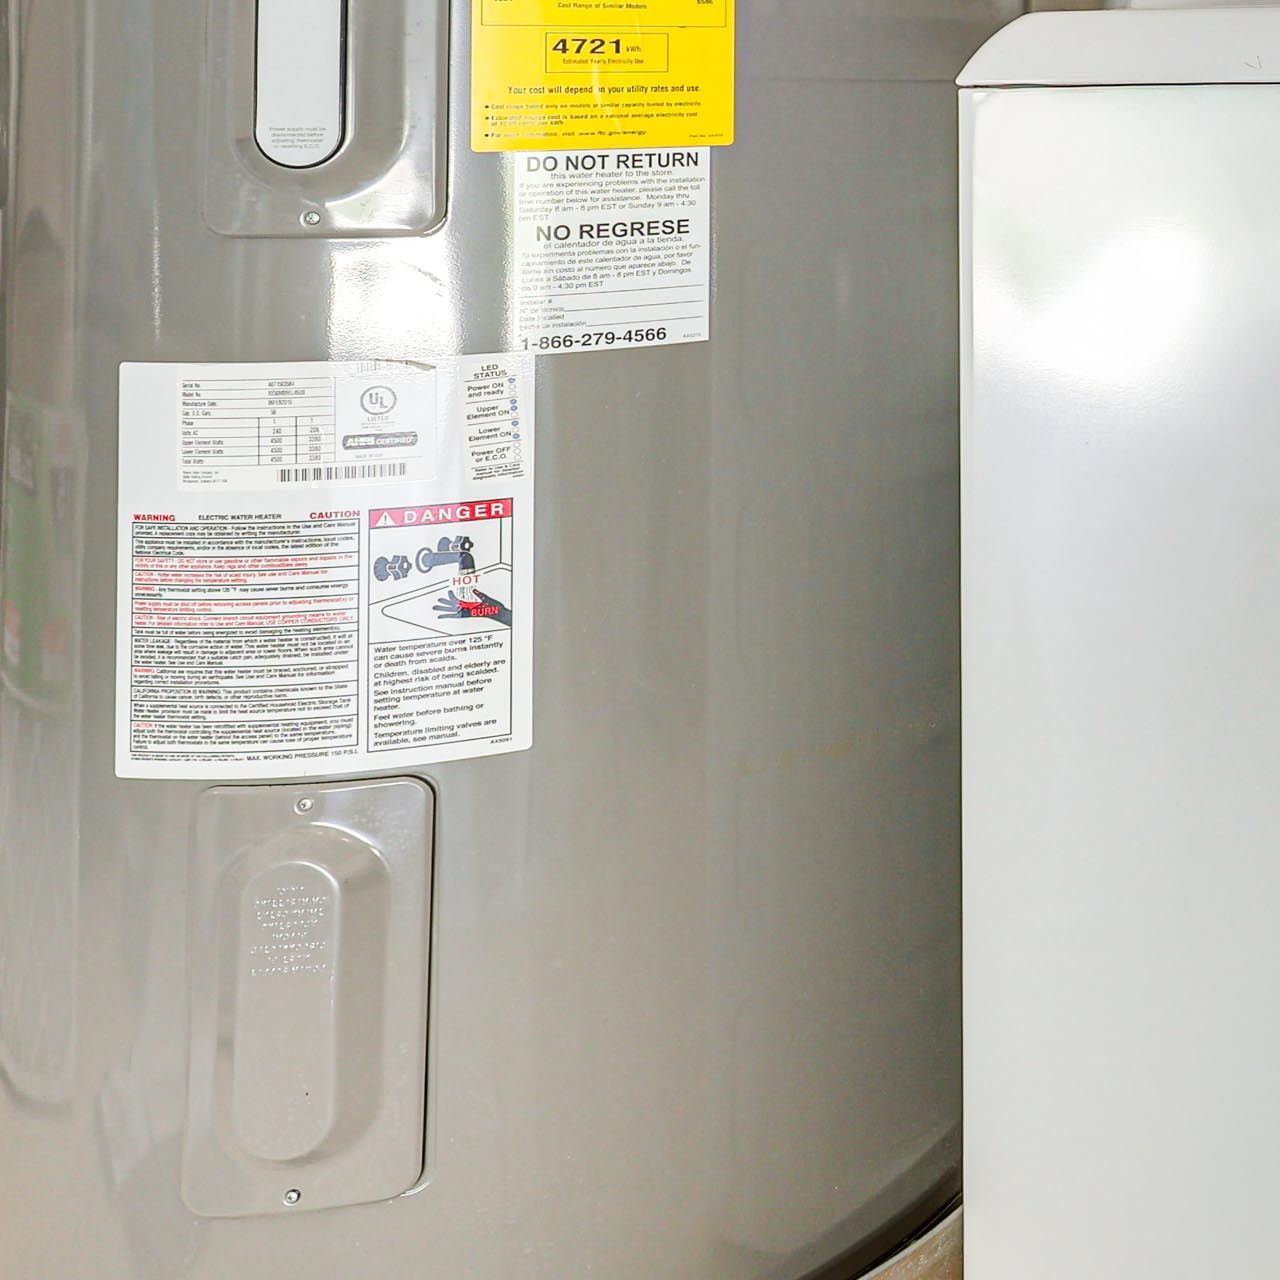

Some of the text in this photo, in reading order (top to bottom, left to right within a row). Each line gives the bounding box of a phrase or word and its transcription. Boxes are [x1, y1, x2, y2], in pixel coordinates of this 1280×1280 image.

[572, 2, 593, 10] Range
[552, 38, 642, 54] 4721 kWh
[507, 85, 527, 95] Your
[529, 85, 545, 94] cost
[548, 85, 562, 94] will
[564, 85, 593, 95] depend
[607, 85, 624, 95] your
[626, 84, 648, 95] utility
[650, 85, 669, 93] rates
[670, 84, 685, 93] and
[527, 152, 699, 172] DO NOT RETURN
[595, 170, 623, 178] heater
[635, 169, 649, 177] the
[536, 219, 690, 242] NO REGRESE
[553, 241, 600, 249] calentador
[615, 239, 637, 247] agua
[521, 327, 667, 351] 1-866-279-4566
[473, 370, 507, 379] STATUS
[467, 384, 490, 392] Power
[369, 392, 388, 409] UL
[467, 412, 496, 420] Element
[468, 434, 498, 442] Element
[471, 449, 494, 457] Power
[133, 513, 176, 522] WARNING
[309, 510, 361, 520] CAUTION
[403, 502, 504, 524] DANGER
[452, 575, 480, 586] HOT
[471, 607, 499, 617] BURN
[390, 652, 414, 660] cause
[444, 646, 467, 654] burns
[469, 641, 504, 651] instantly
[398, 641, 447, 651] temperature
[384, 659, 406, 667] death
[408, 657, 427, 665] from
[374, 671, 409, 679] Children,
[411, 666, 445, 675] disabled
[464, 660, 491, 669] elderly
[383, 677, 413, 686] highest
[415, 674, 429, 682] risk
[441, 670, 464, 679] being
[390, 684, 433, 695] instruction
[435, 681, 464, 689] manual
[466, 677, 492, 686] before
[374, 696, 401, 704] setting
[403, 690, 451, 701] temperature
[463, 686, 484, 694] water
[392, 711, 414, 719] water
[416, 708, 441, 717] before
[443, 703, 474, 713] bathing
[374, 729, 423, 739] Temperature
[425, 723, 454, 733] limiting
[456, 720, 482, 729] valves
[263, 753, 293, 761] WORKING
